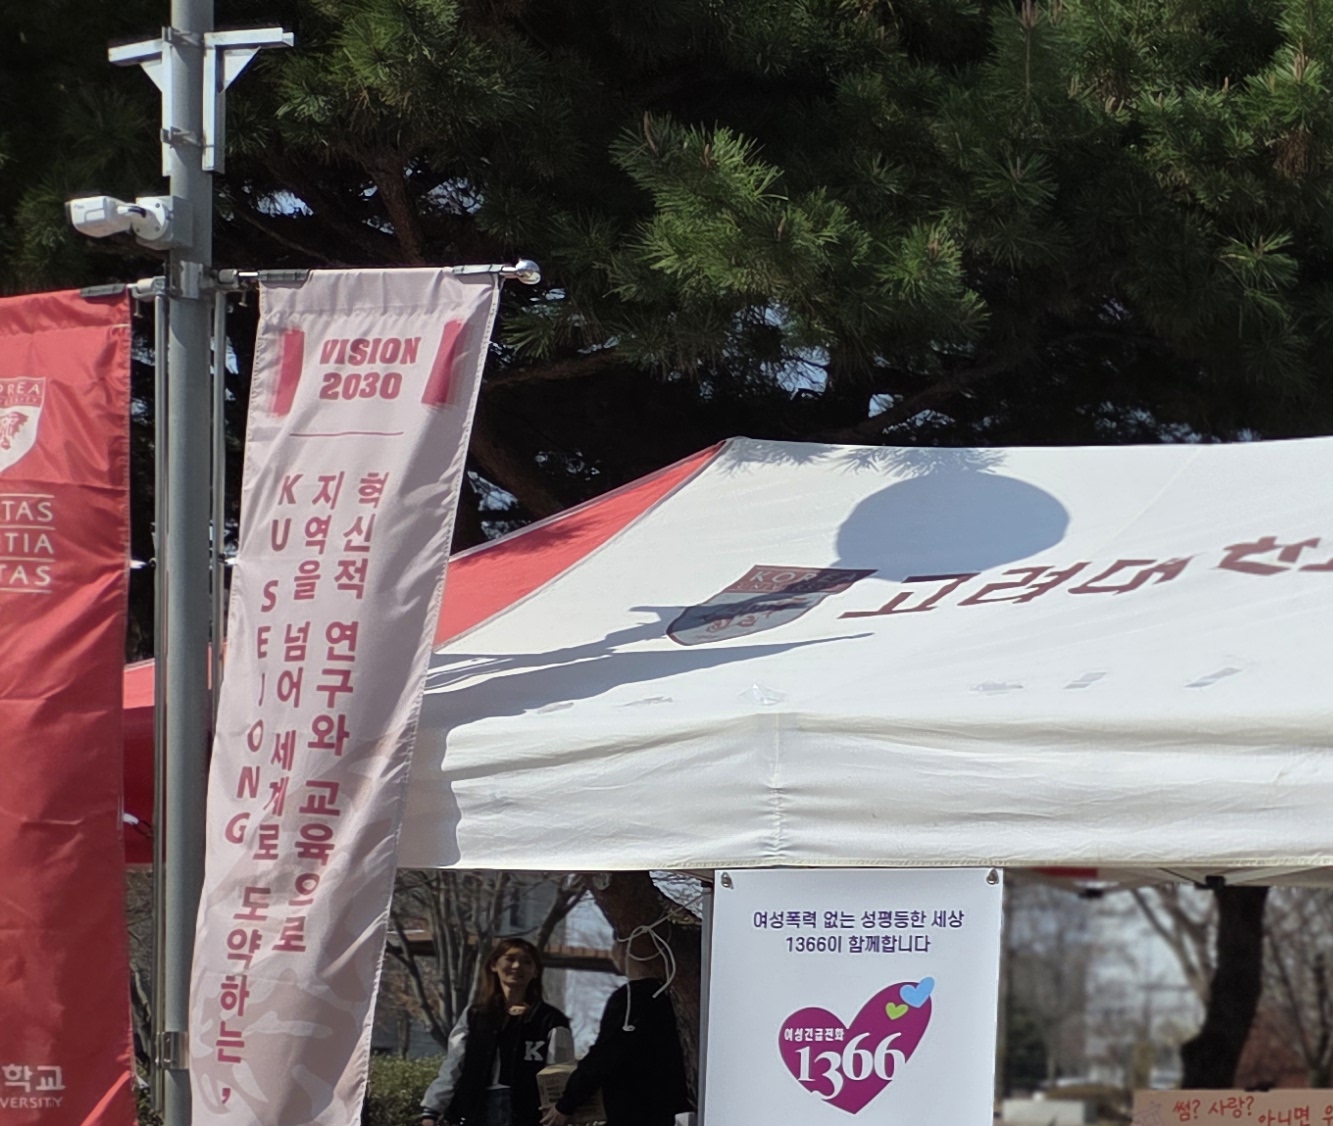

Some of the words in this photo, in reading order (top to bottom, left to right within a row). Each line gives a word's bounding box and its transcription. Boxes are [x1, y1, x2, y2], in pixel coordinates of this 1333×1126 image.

[319, 336, 422, 366] VISION
[319, 372, 403, 400] 2030
[293, 471, 345, 600] 지역을
[333, 471, 390, 600] 혁신적
[276, 620, 311, 710] 넘어
[307, 620, 360, 757] 연구와
[252, 729, 297, 861] 세계로
[271, 779, 341, 952] 교육으로
[753, 910, 817, 928] 여성폭력
[823, 911, 855, 928] 없는
[860, 911, 927, 928] 성평등한
[931, 910, 964, 928] 세상
[786, 935, 842, 953] 1366이
[848, 935, 931, 953] 함께합니다
[784, 1028, 845, 1042] 여성긴급전화
[524, 1041, 545, 1061] K
[795, 1032, 906, 1100] 1366
[2, 1064, 66, 1093] 학교
[1173, 1099, 1201, 1122] 썸?
[1208, 1095, 1255, 1119] 사랑?
